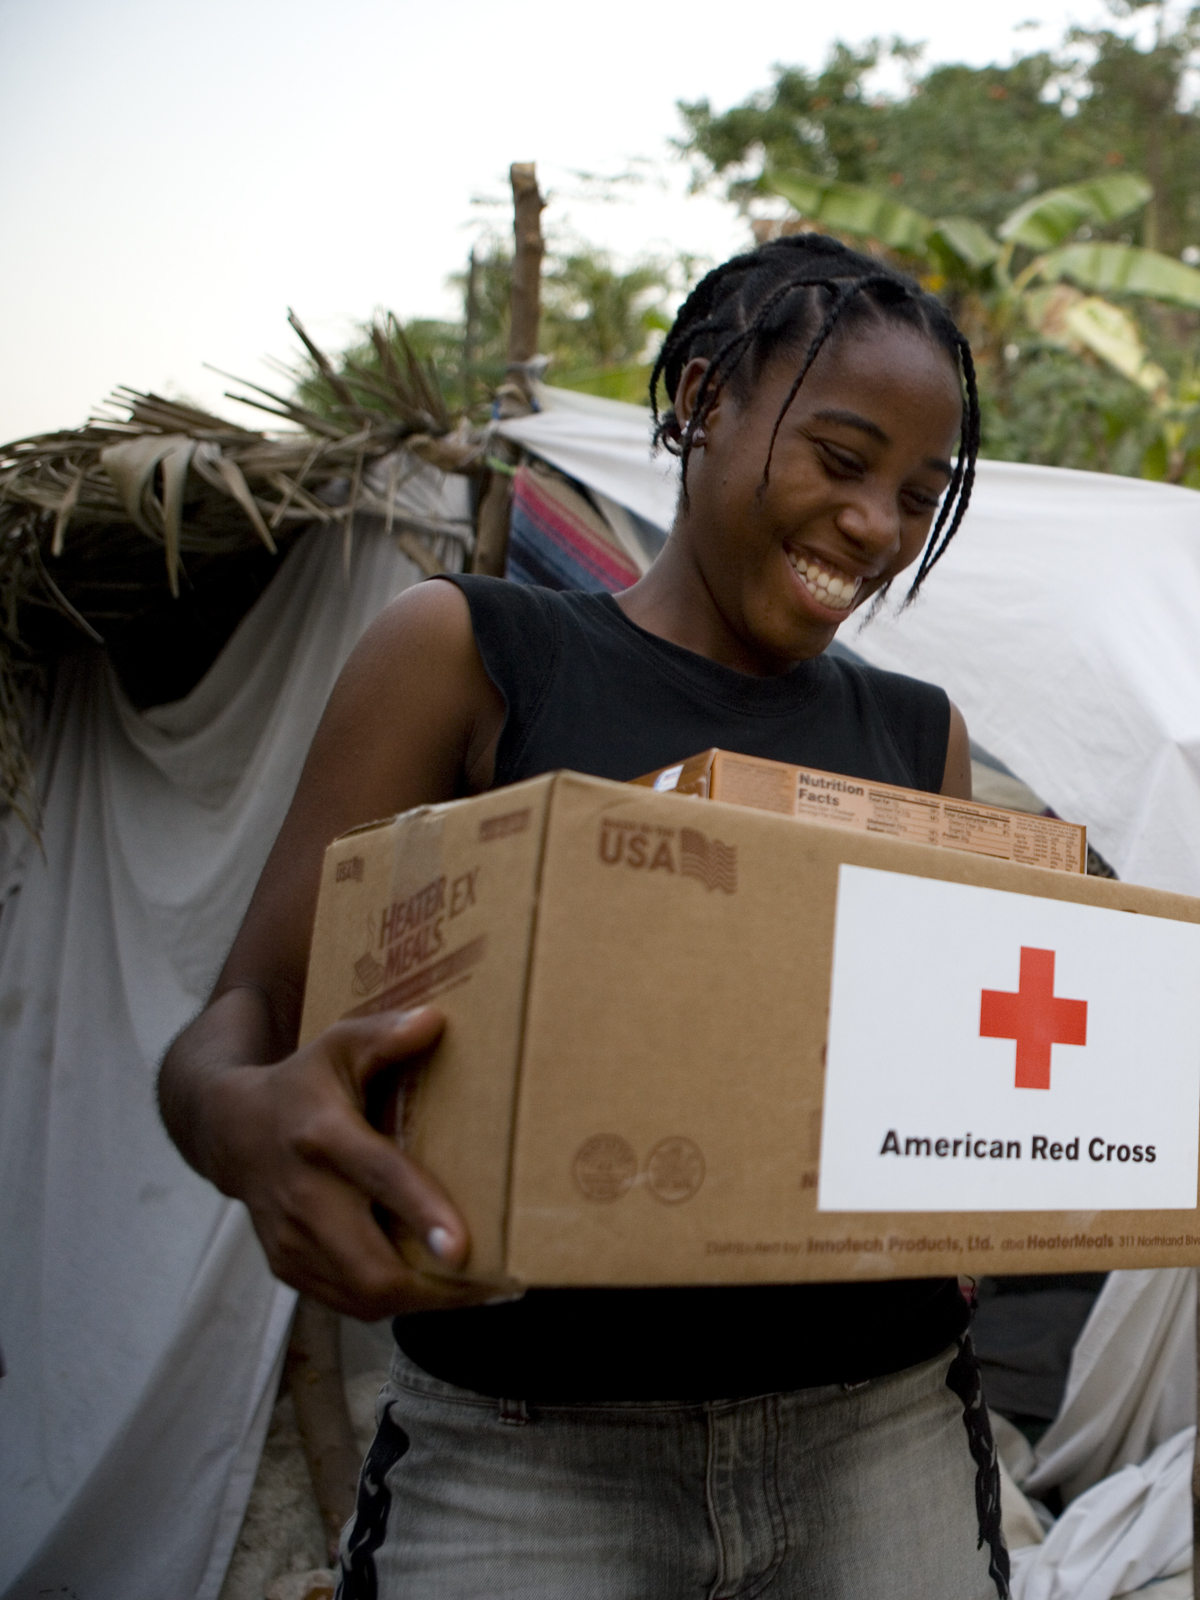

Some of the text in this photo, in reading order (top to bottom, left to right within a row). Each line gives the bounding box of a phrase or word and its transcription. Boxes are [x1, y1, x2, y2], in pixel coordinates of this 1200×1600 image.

[799, 788, 840, 807] Facts
[800, 773, 864, 797] Nutrition
[599, 829, 676, 874] USA
[336, 863, 354, 883] USA
[378, 865, 482, 950] HEATER EX
[384, 916, 445, 985] MEALS
[880, 1129, 1157, 1163] American Red Cross
[806, 1236, 884, 1254] Innotech
[888, 1235, 962, 1254] Products,
[968, 1235, 995, 1251] Ltd.
[1027, 1233, 1114, 1249] HeaterMeals
[1119, 1235, 1135, 1247] 311
[1138, 1235, 1183, 1247] Northland
